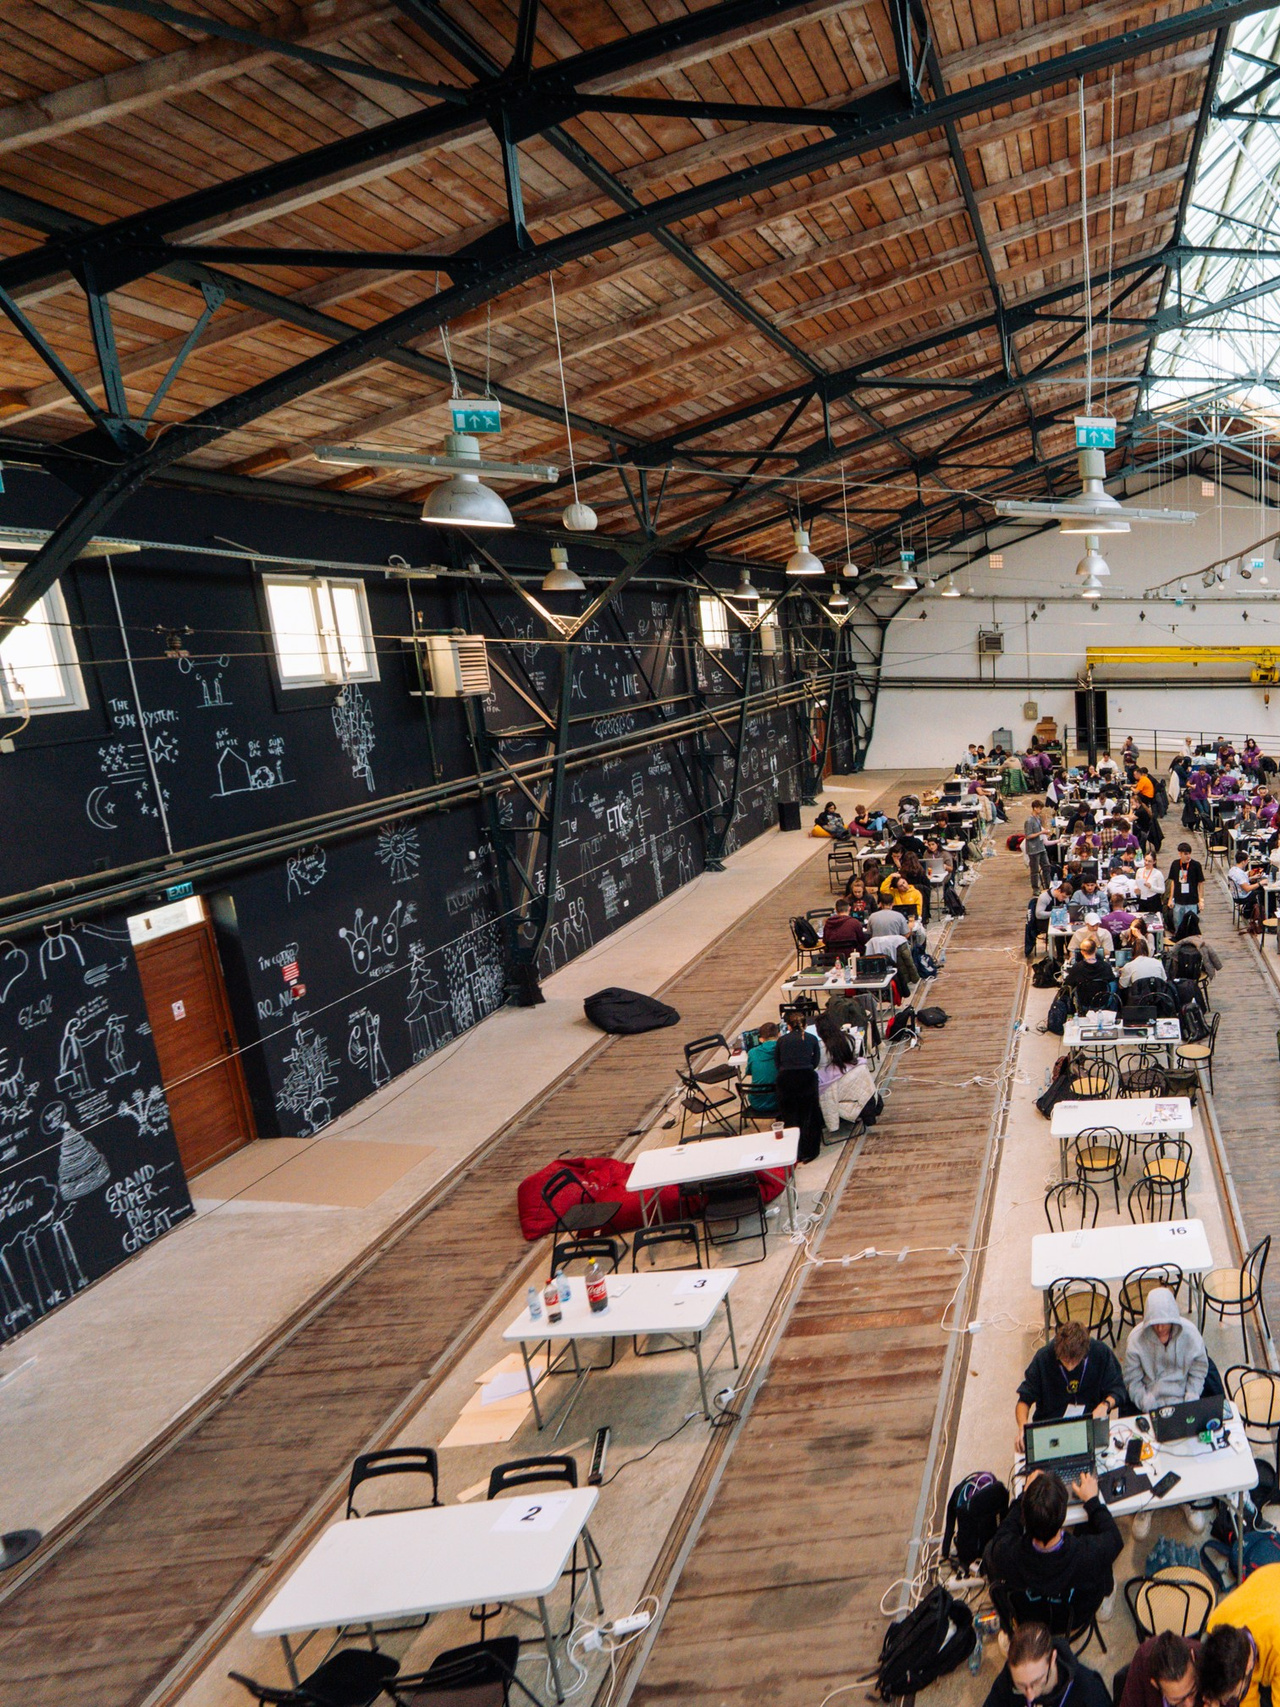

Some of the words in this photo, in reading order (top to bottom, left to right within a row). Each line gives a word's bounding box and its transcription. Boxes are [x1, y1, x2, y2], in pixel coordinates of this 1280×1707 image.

[108, 698, 129, 712] THE
[169, 884, 191, 897] EXIT
[105, 1164, 155, 1204] GRAND
[110, 1183, 159, 1219] SUPER
[126, 1204, 153, 1229] BIG
[122, 1207, 173, 1252] GREAT
[1169, 1227, 1187, 1235] 16
[693, 1278, 707, 1288] 3
[521, 1506, 542, 1521] 2
